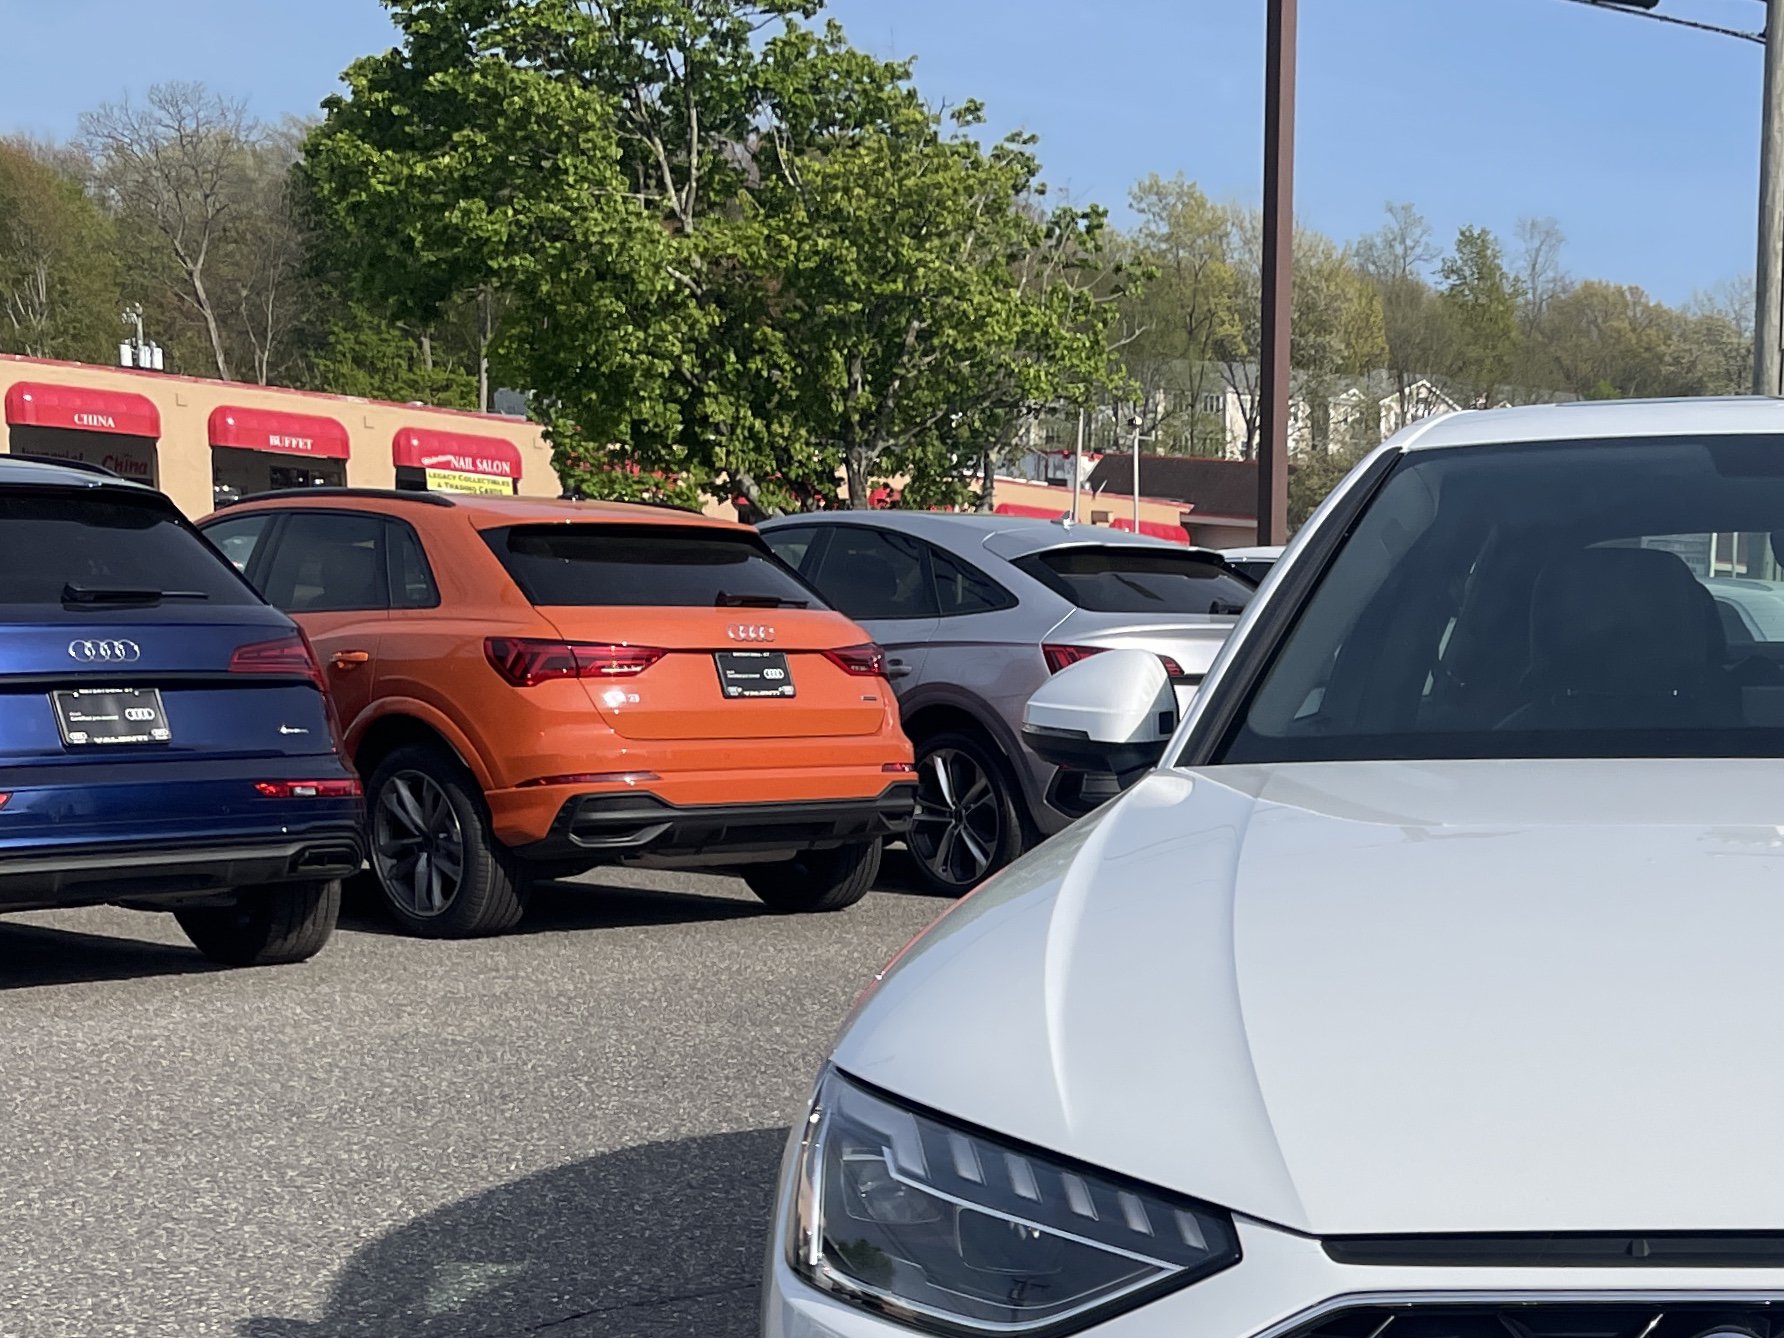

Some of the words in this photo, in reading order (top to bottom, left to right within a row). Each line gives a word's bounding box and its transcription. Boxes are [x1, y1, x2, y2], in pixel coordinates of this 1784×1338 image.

[74, 413, 115, 428] CHINA
[269, 434, 313, 450] BUFFET
[102, 454, 148, 475] China
[450, 455, 475, 471] NAIL
[477, 457, 511, 474] SALON
